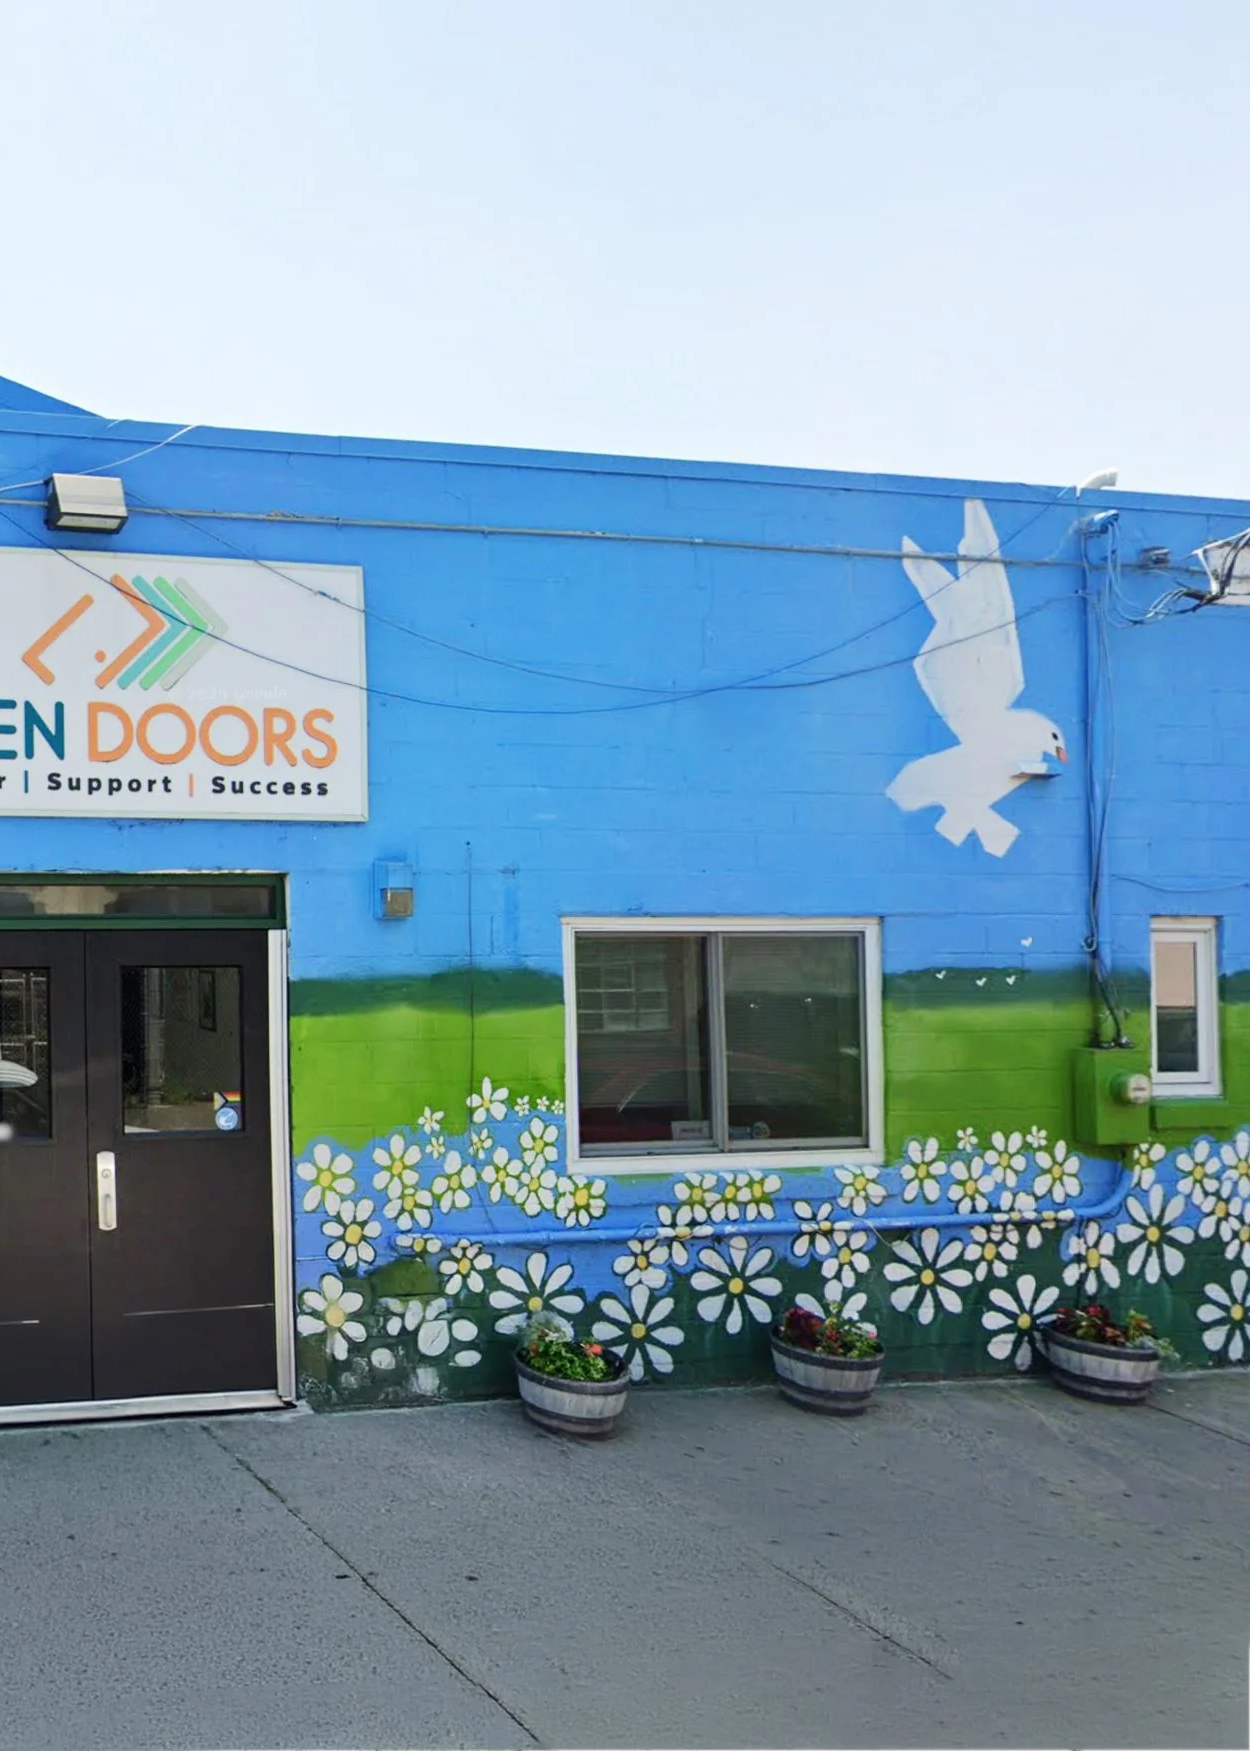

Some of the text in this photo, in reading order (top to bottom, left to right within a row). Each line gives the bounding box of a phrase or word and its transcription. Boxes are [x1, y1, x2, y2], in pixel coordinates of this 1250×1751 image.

[87, 701, 338, 769] DOORS
[46, 772, 173, 796] Support
[211, 776, 329, 797] Success
